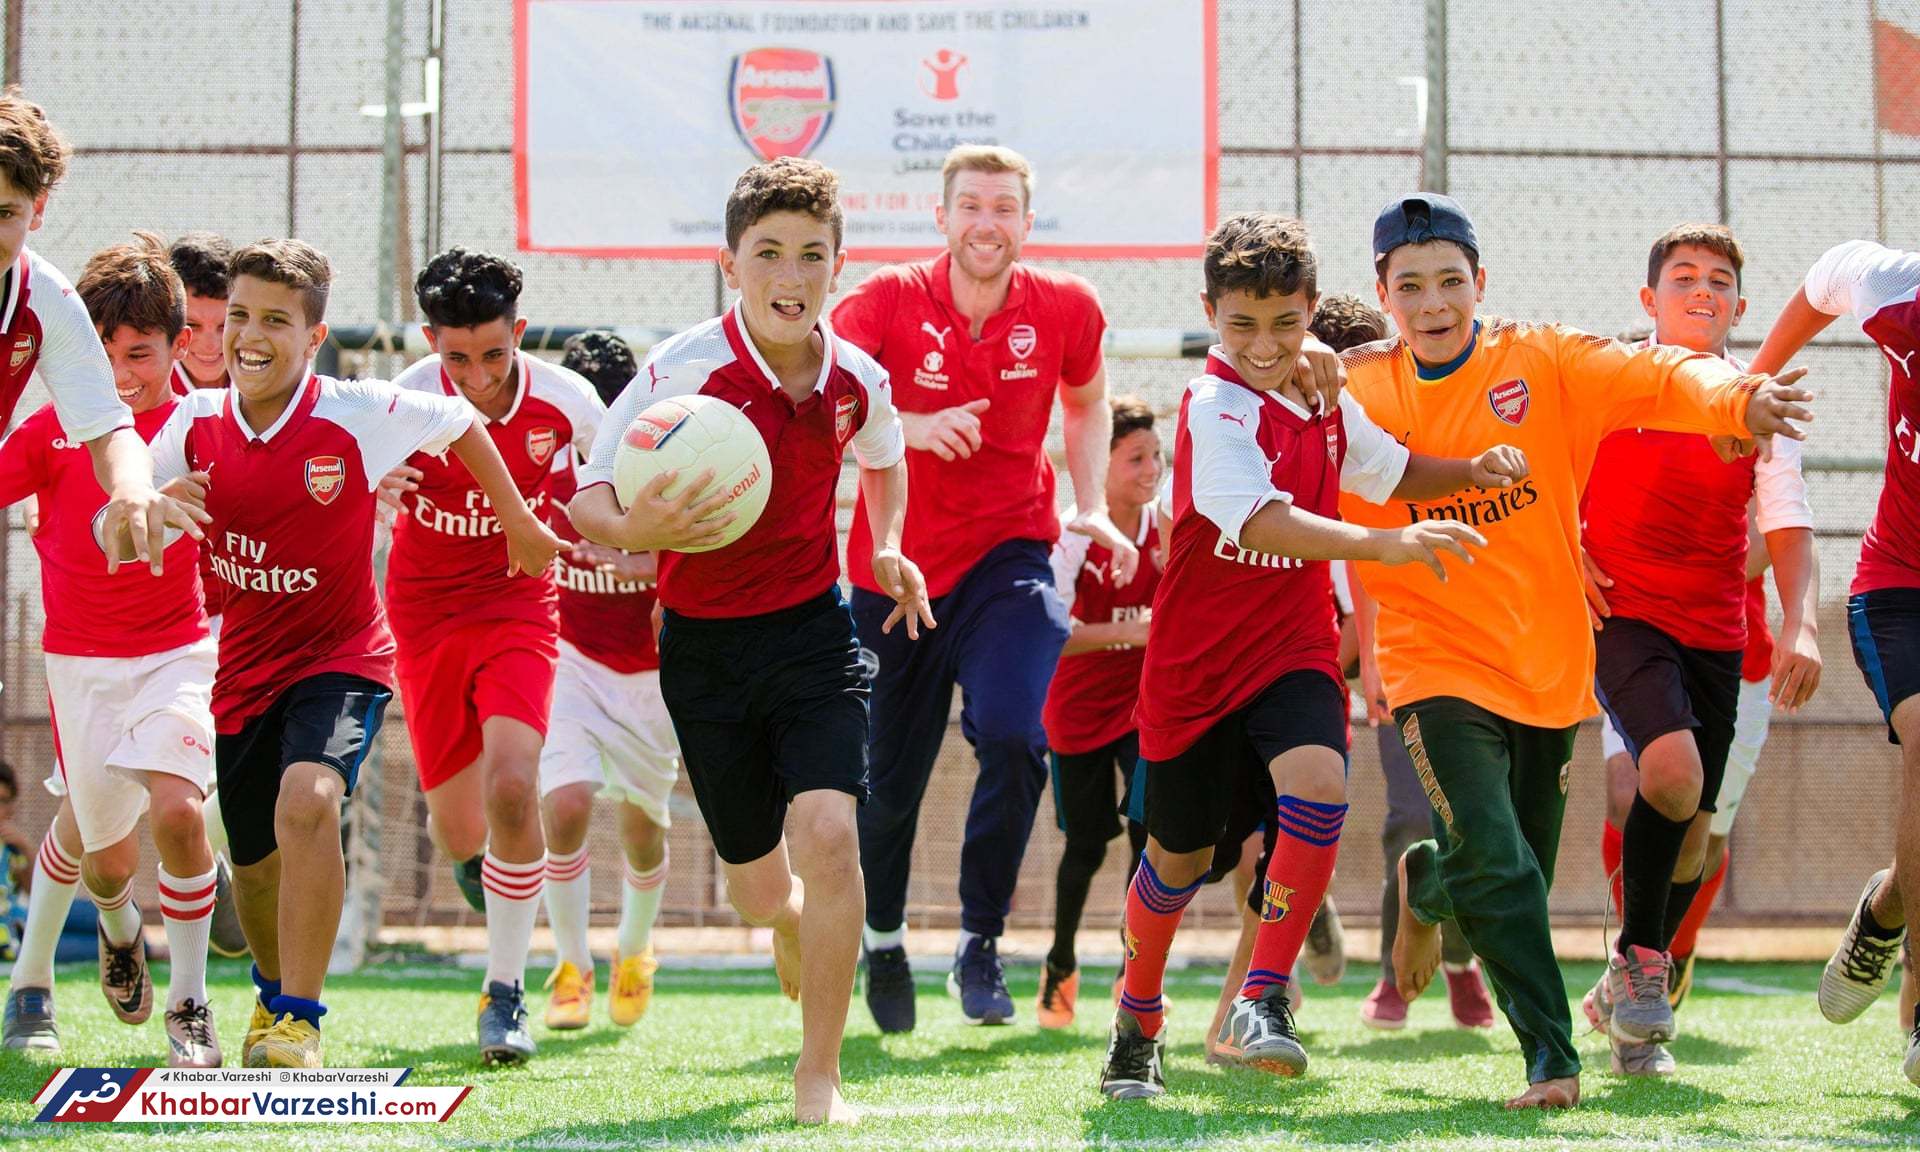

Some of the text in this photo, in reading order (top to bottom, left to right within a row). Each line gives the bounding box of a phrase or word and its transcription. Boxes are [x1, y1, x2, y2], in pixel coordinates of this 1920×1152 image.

[893, 108, 996, 127] Save the
[1493, 383, 1522, 401] Arsenal
[311, 462, 341, 473] Arsenal
[727, 463, 761, 504] senal
[465, 489, 492, 509] Fl
[225, 531, 267, 564] Fly
[207, 552, 318, 594] mirates
